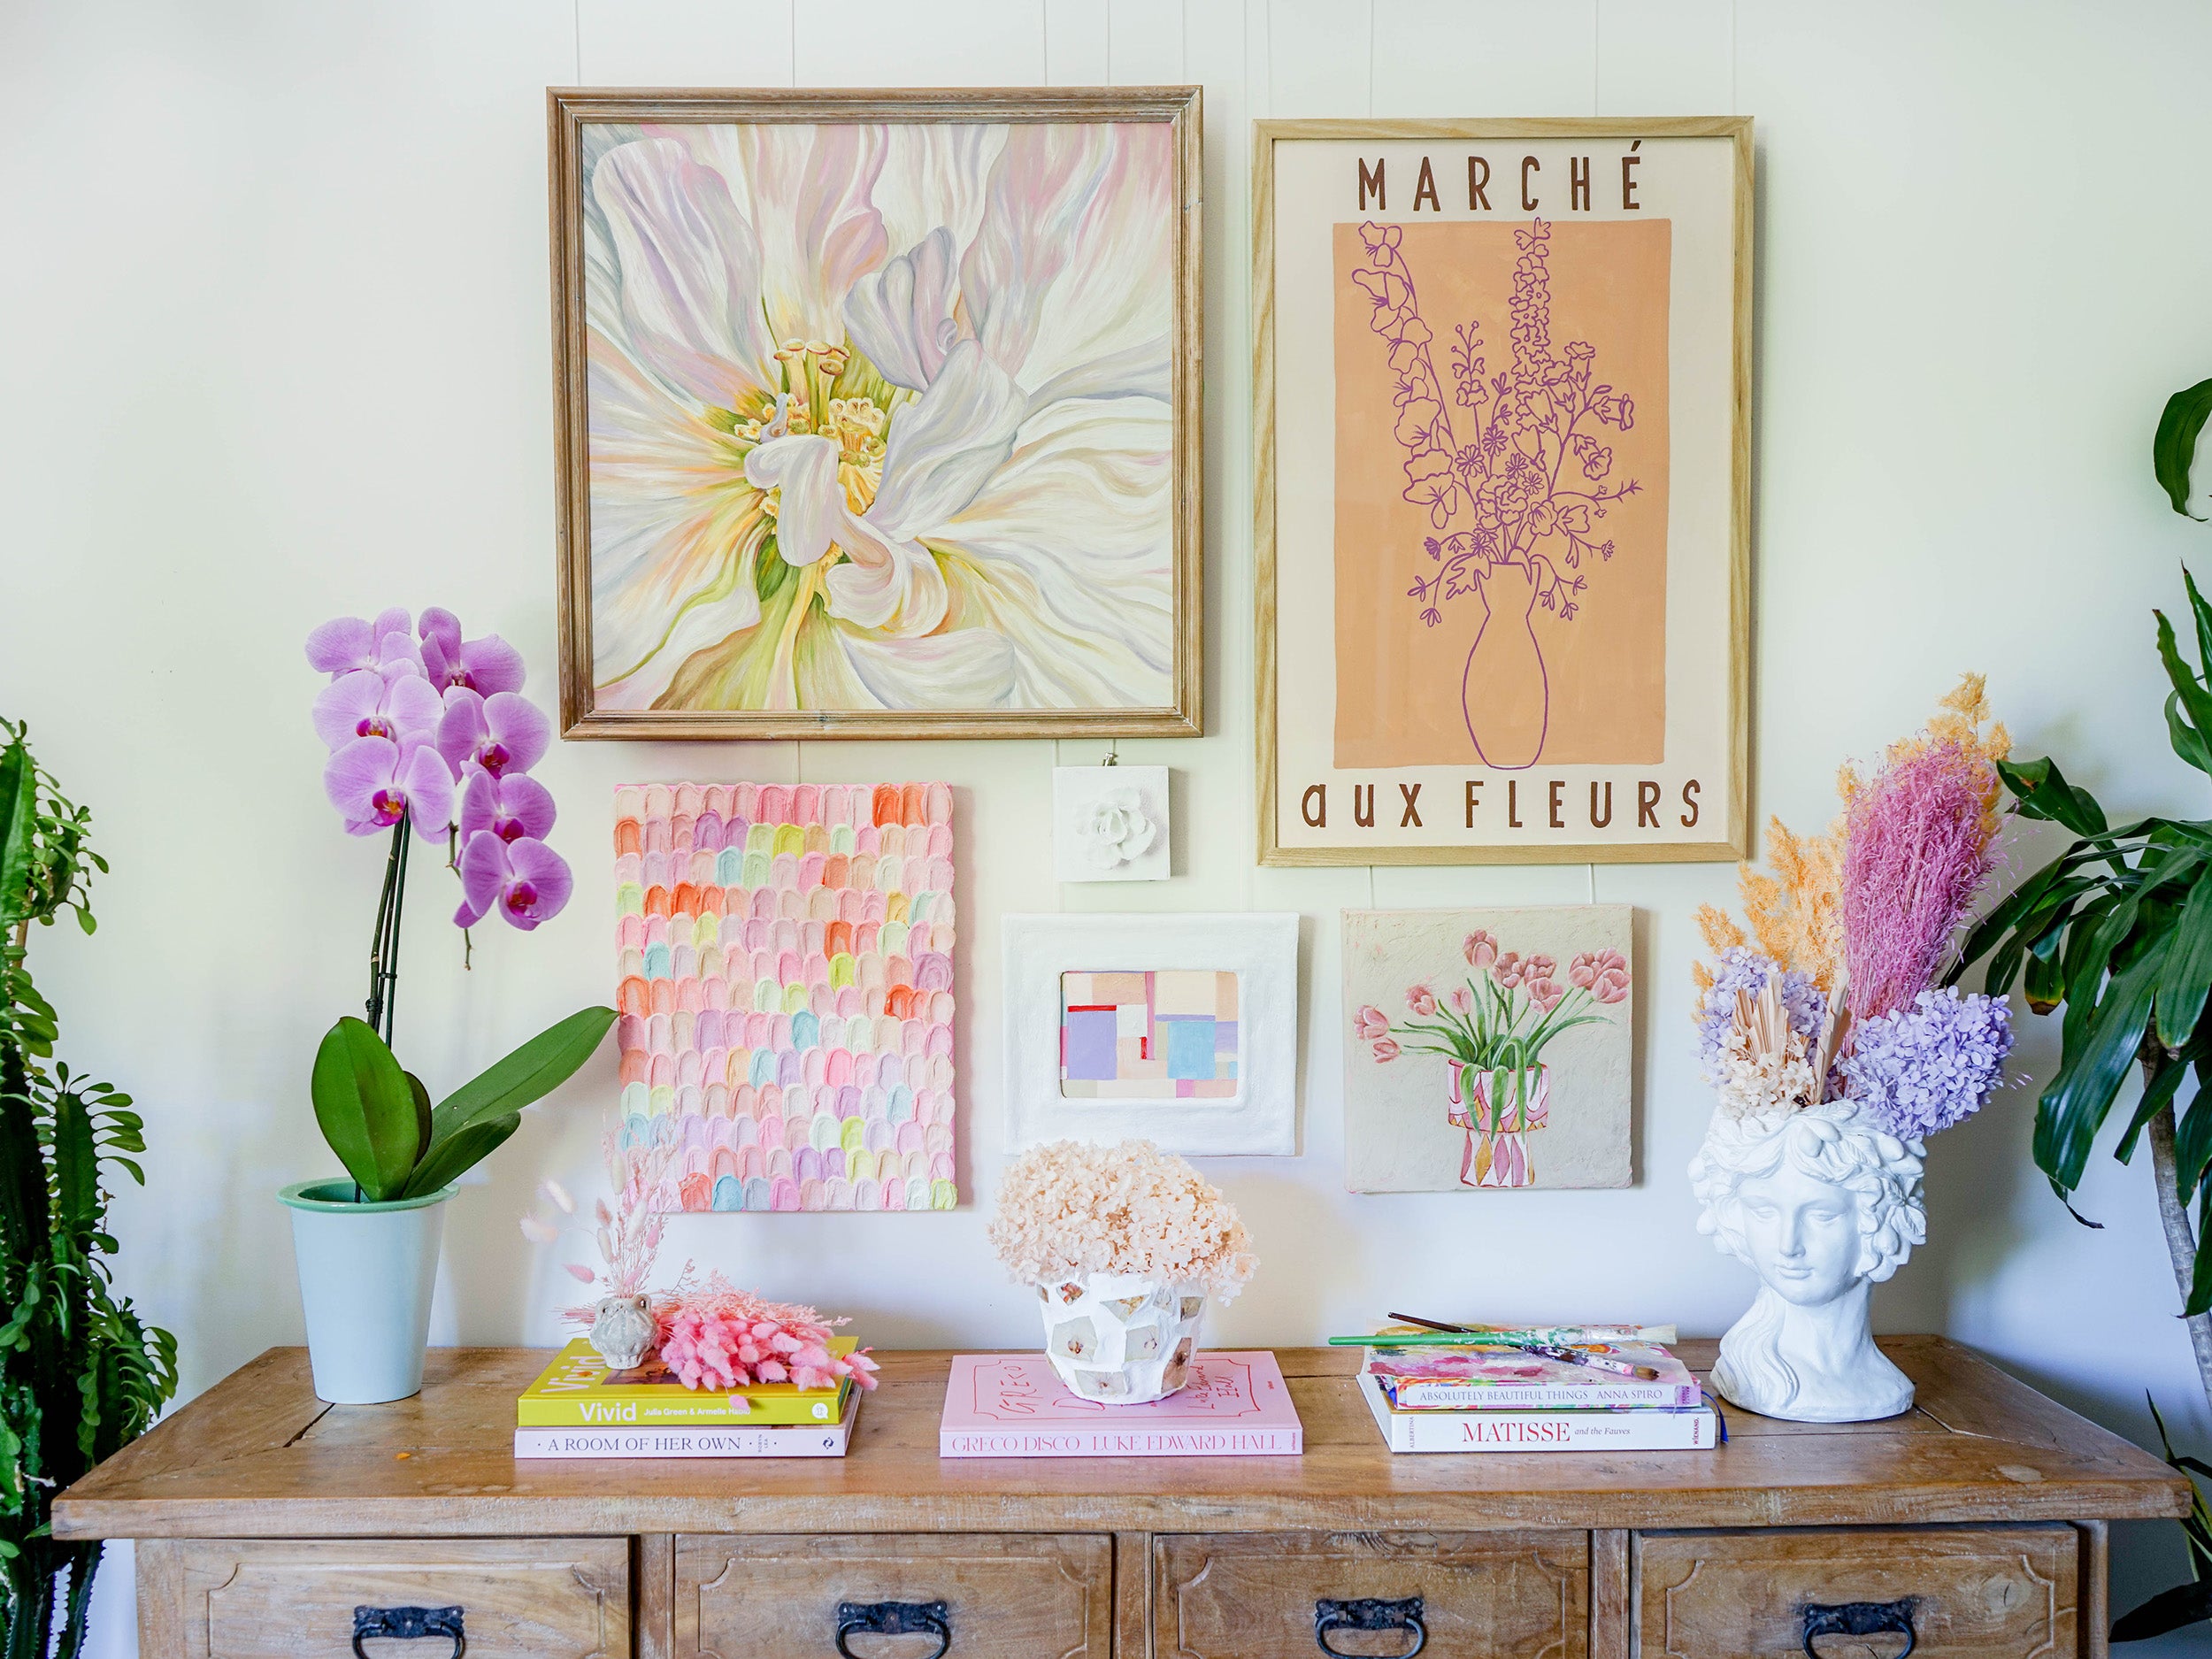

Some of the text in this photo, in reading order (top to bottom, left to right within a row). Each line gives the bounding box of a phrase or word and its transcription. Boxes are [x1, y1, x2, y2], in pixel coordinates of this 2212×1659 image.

[1358, 140, 1643, 211] MARCHÉ
[1465, 779, 1701, 828] FLEURS
[1419, 1389, 1663, 1401] ABSOLUTELY BEAUTIFUL THINGS ANNA SPIRO
[579, 1402, 637, 1421] Vivid
[1463, 1422, 1631, 1442] MATISSE and the Fauves
[548, 1436, 741, 1451] A ROOM OF HER OWN
[952, 1434, 1281, 1452] GRECO DISCO LUKE EDWARD HALL
